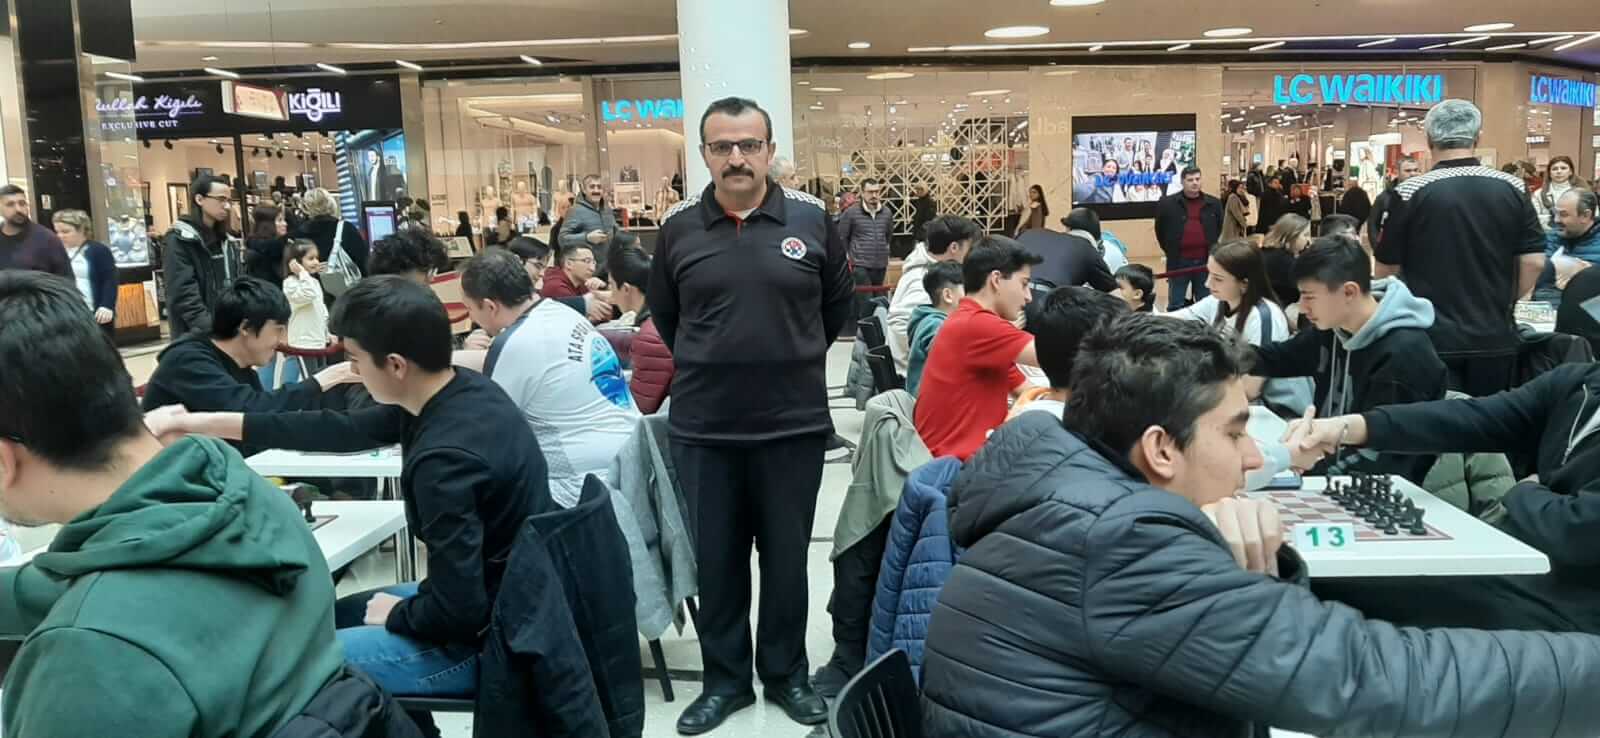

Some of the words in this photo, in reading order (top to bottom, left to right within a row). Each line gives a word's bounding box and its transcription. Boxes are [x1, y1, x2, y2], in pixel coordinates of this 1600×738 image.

[1274, 74, 1314, 104] LC
[1530, 75, 1548, 103] LC
[602, 99, 633, 121] LC
[101, 120, 156, 130] EXCLUSIVE
[158, 120, 178, 128] CUT
[567, 342, 584, 362] ATA
